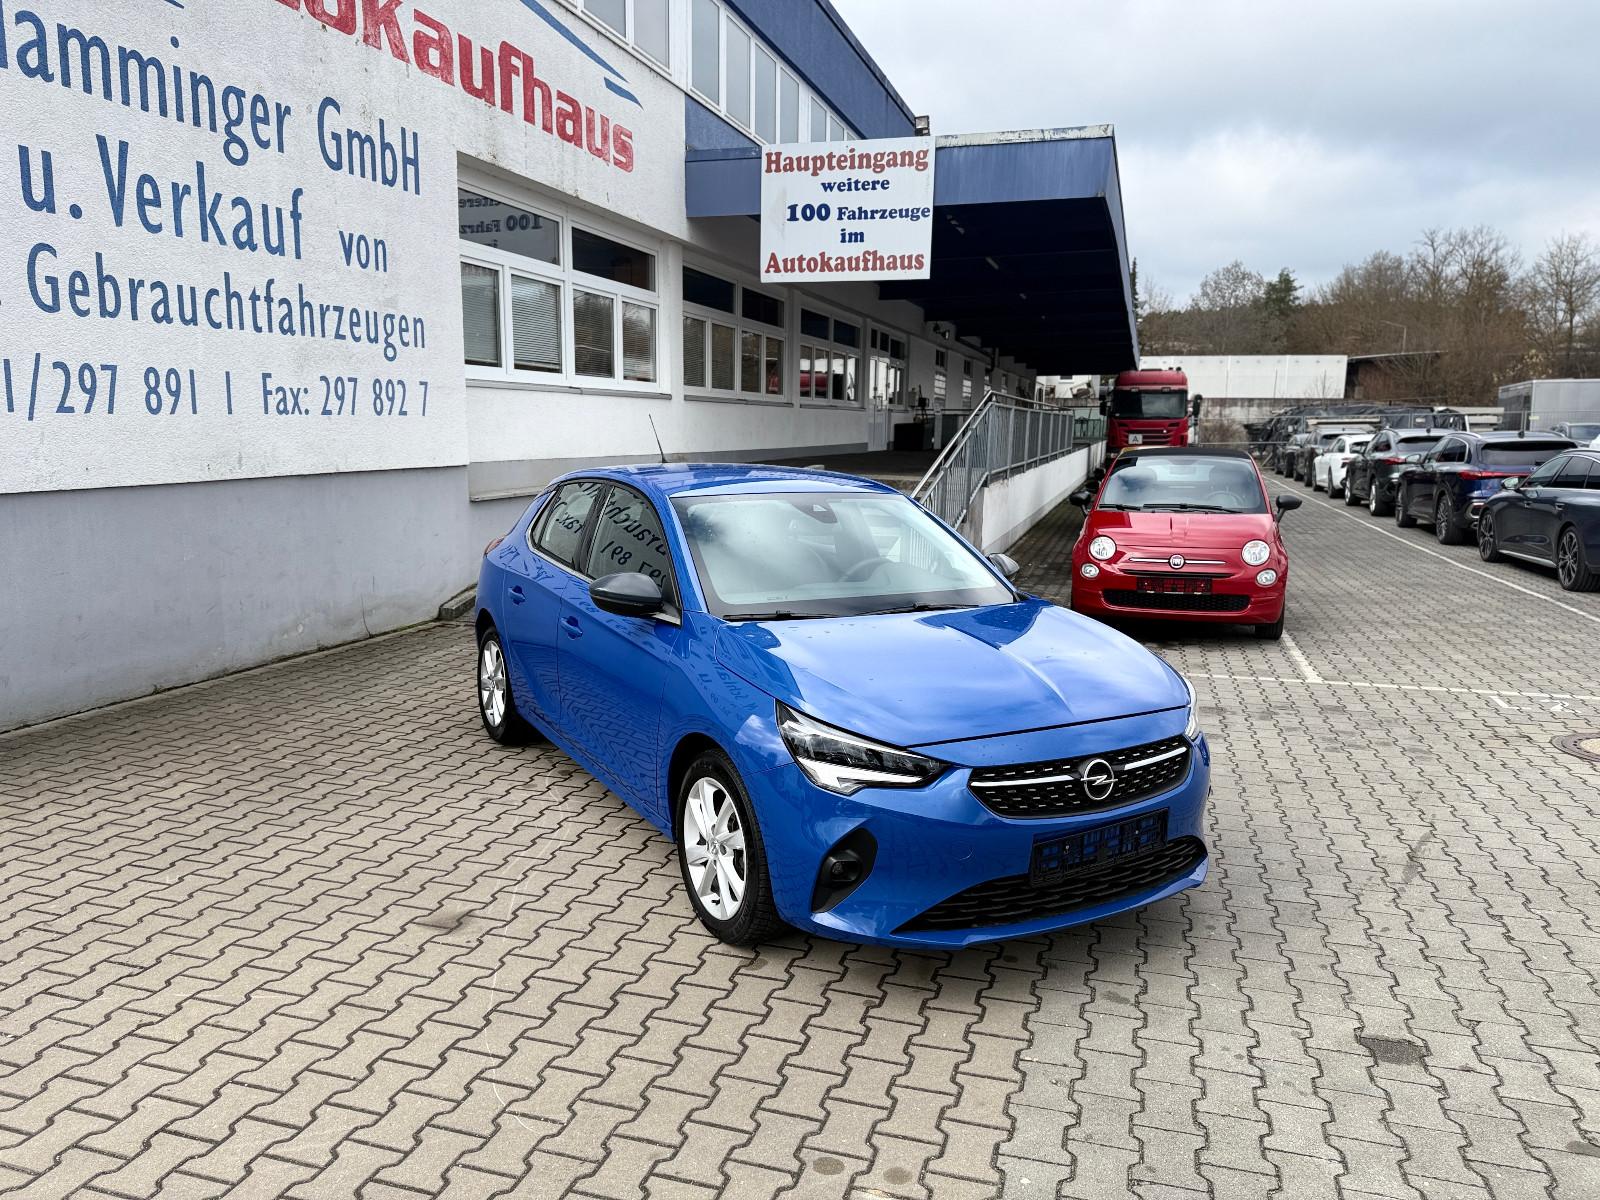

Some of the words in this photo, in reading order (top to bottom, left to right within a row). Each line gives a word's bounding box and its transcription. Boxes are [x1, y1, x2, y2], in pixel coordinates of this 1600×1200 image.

[316, 96, 421, 195] GmbH
[765, 148, 929, 176] Haupteingang
[820, 178, 891, 193] weitere
[17, 144, 83, 220] u.
[96, 134, 303, 260] Verkauf
[338, 230, 388, 273] von
[786, 203, 831, 222] 100
[836, 206, 931, 222] Fahrzeuge
[840, 228, 865, 244] im
[765, 250, 925, 273] Autokaufhaus
[27, 242, 425, 363] Gebrauchtfahrzeugen
[262, 373, 309, 416] Fax:
[319, 375, 358, 416] 297
[372, 377, 408, 417] 892
[420, 381, 429, 416] 7
